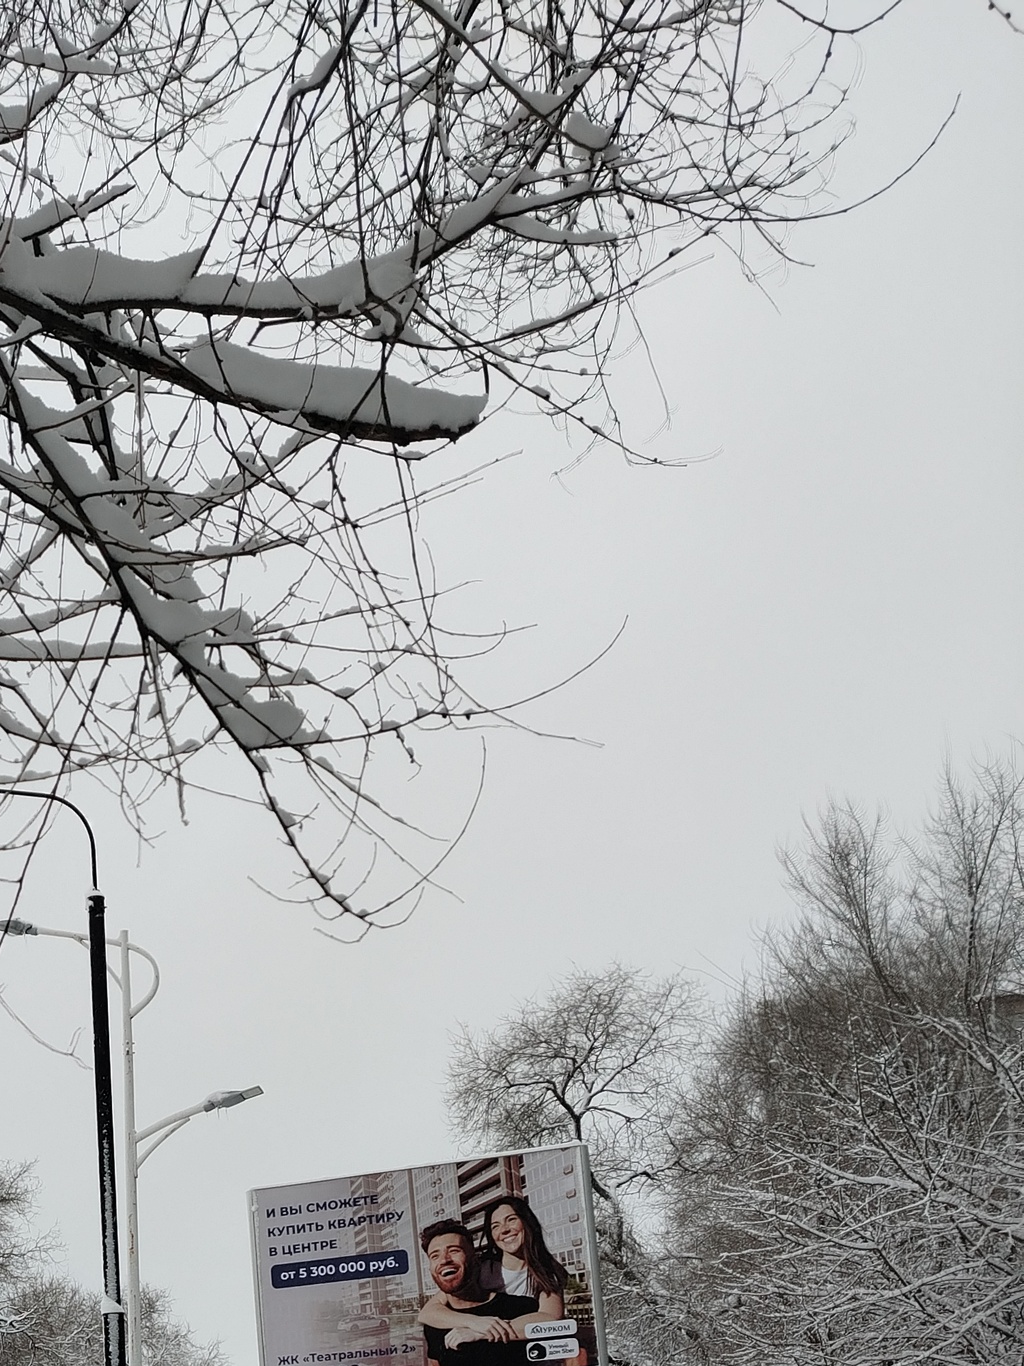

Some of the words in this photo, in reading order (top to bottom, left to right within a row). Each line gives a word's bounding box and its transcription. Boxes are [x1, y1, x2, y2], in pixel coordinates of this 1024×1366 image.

[266, 1208, 276, 1218] И
[280, 1205, 302, 1217] ВЫ
[306, 1194, 379, 1213] СМОЖЕТЕ
[267, 1222, 324, 1238] КУПИТЬ
[328, 1210, 405, 1230] КВАРТИРУ
[269, 1247, 278, 1256] В
[282, 1239, 338, 1256] ЦЕНТРЕ
[280, 1271, 296, 1280] от
[299, 1267, 307, 1278] 5
[310, 1265, 335, 1277] 300
[339, 1260, 366, 1273] 000
[369, 1256, 399, 1272] руб.
[278, 1355, 299, 1366] ЖК
[303, 1345, 398, 1362] «Театральный
[401, 1343, 416, 1354] 2»
